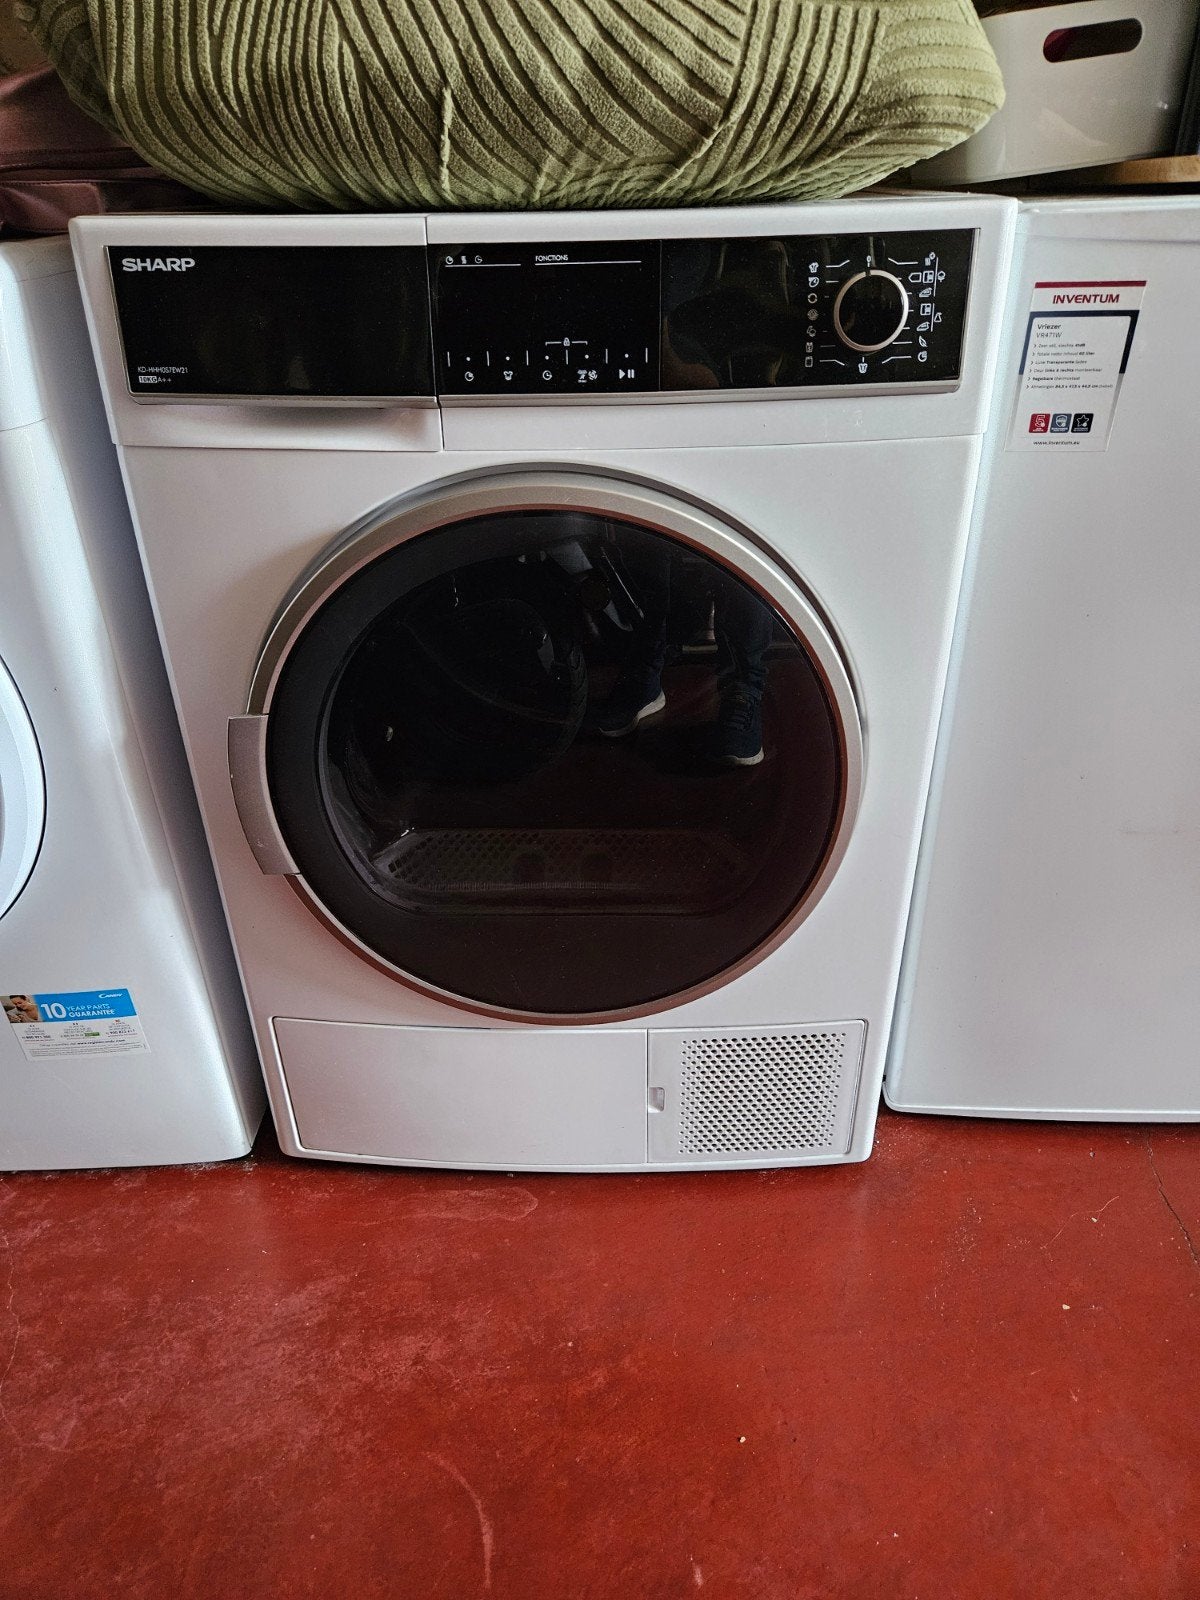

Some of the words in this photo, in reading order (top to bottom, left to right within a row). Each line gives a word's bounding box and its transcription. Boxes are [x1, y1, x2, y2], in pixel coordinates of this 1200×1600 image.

[536, 254, 568, 262] FONCTIONS
[122, 257, 196, 272] SHARP
[1053, 294, 1120, 304] INVENTUM
[157, 376, 172, 384] A++
[40, 1002, 67, 1019] 10
[86, 1003, 111, 1011] PARTS
[68, 1009, 116, 1018] GUARANTEE
